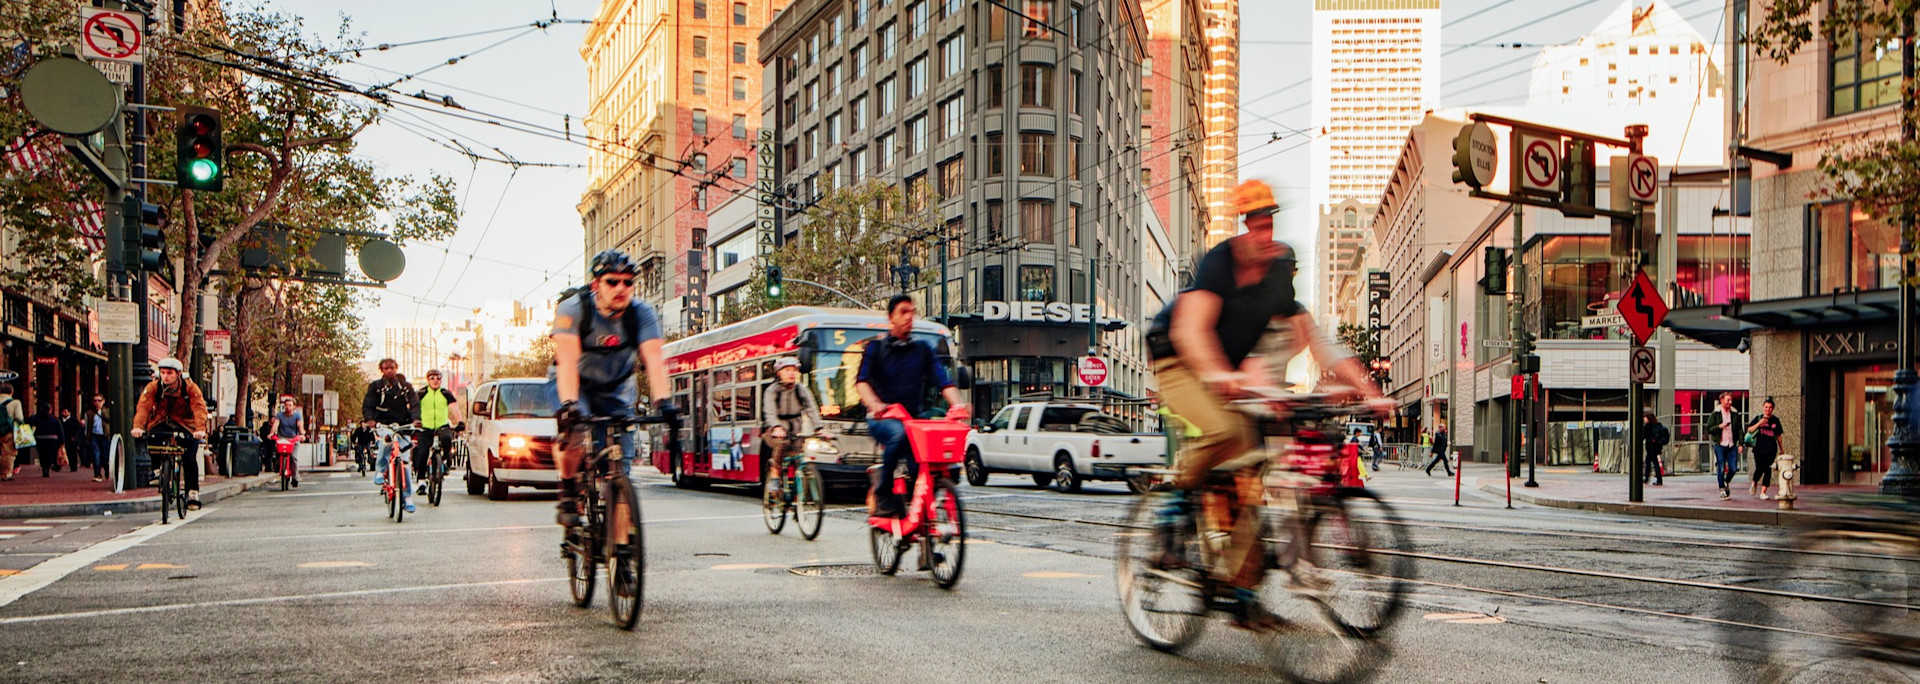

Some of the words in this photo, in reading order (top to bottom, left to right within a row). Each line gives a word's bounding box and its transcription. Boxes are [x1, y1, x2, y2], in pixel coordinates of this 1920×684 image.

[1472, 138, 1496, 157] STOCKTON
[1476, 157, 1490, 171] ELLIS
[983, 300, 1110, 326] DIESEL
[1589, 316, 1622, 326] MARKET
[834, 330, 847, 346] 5
[1814, 331, 1866, 356] XXI
